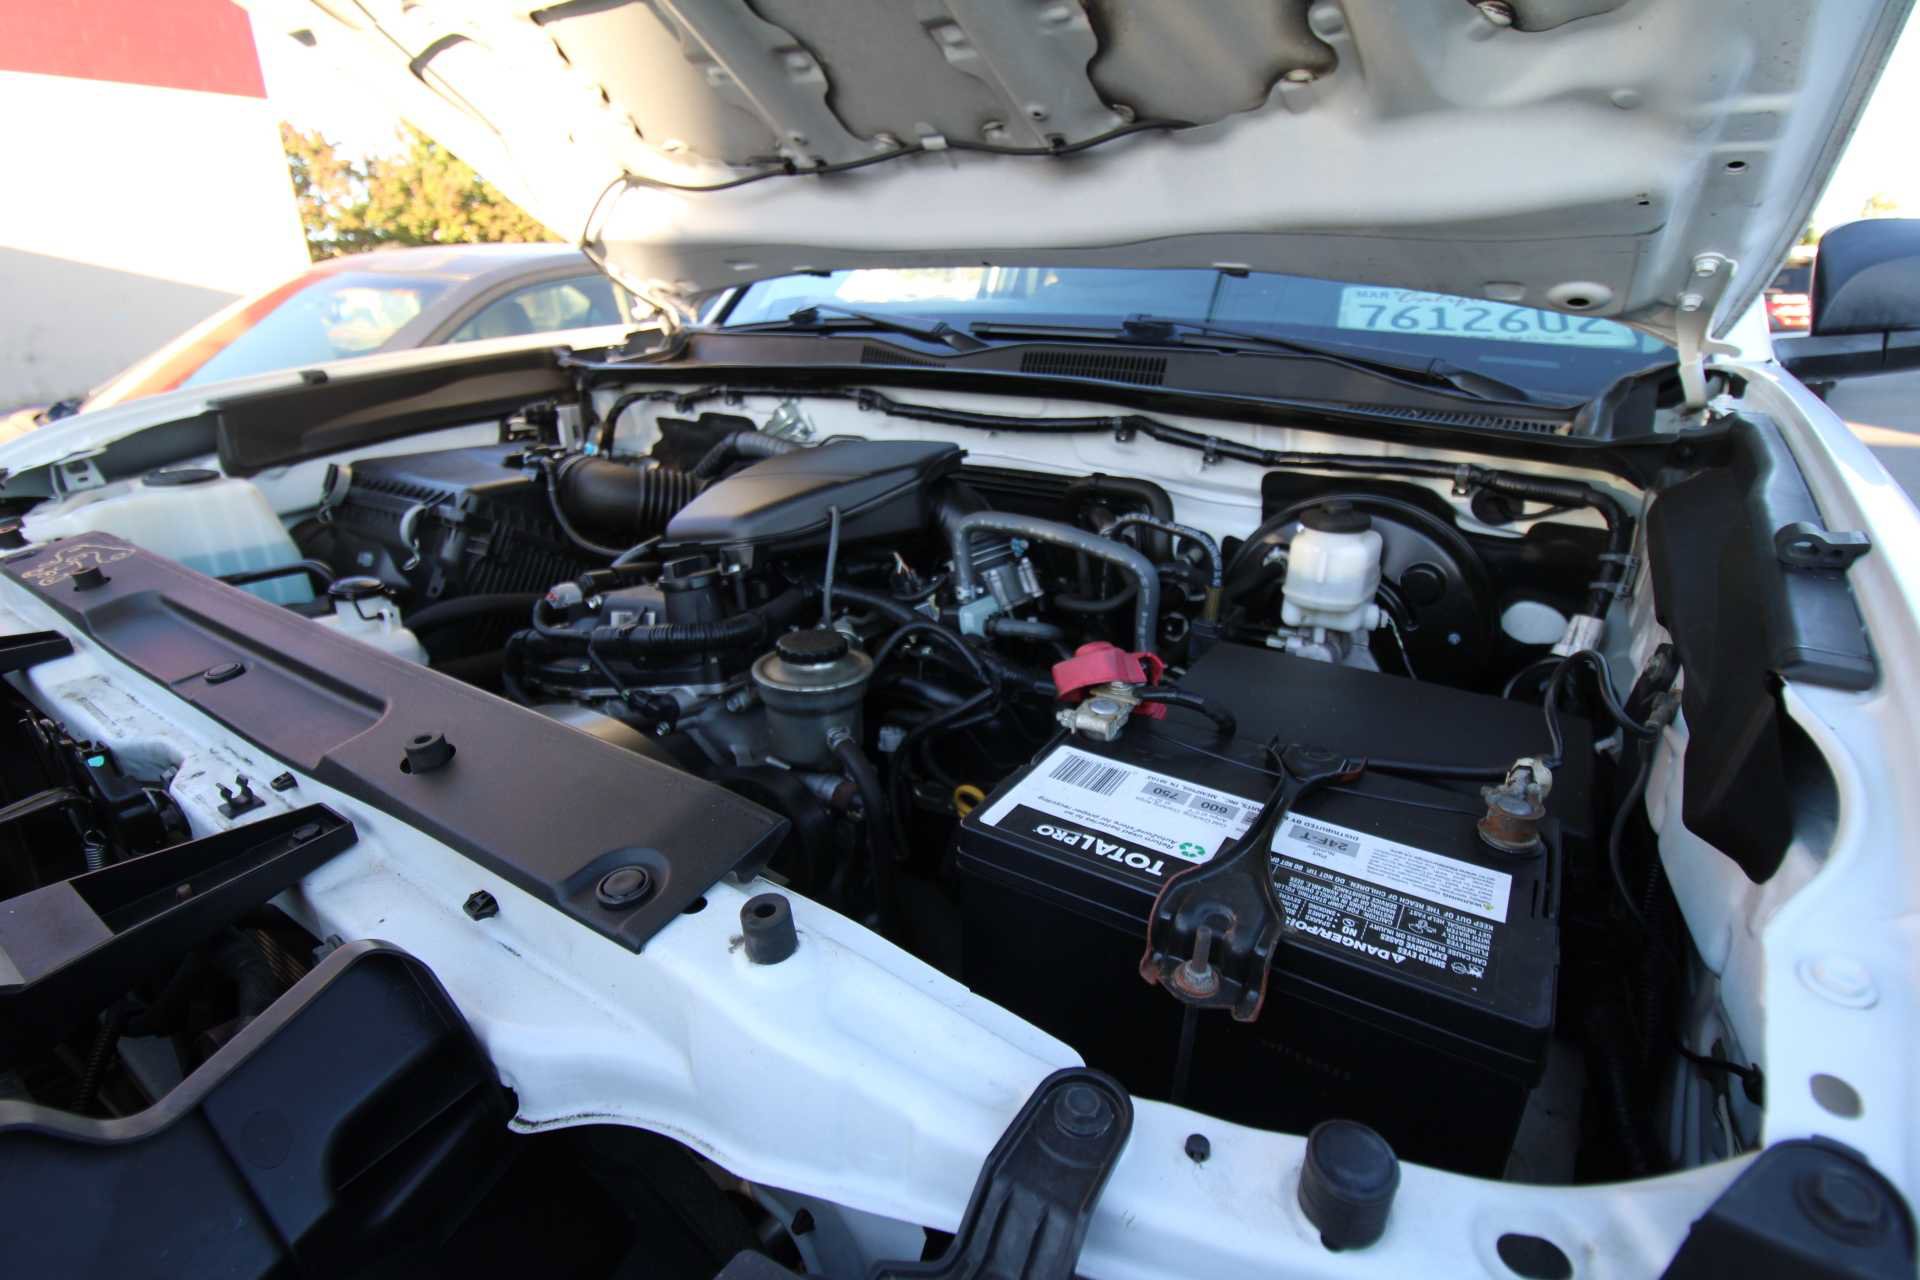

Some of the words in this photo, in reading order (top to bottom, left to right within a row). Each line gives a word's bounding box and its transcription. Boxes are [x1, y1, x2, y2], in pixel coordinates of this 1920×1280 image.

[1359, 304, 1611, 335] 7612602
[1152, 787, 1178, 799] 750
[1200, 801, 1227, 813] 600
[1299, 831, 1347, 850] 24F-T
[1279, 859, 1293, 867] NOT
[1318, 871, 1333, 880] NOT
[1334, 876, 1345, 884] DO
[1308, 902, 1335, 915] SMOKING
[1327, 900, 1346, 909] JUMP
[1399, 897, 1424, 909] REACH
[1307, 909, 1333, 921] FLAMES
[1425, 905, 1440, 915] THE
[1443, 911, 1453, 919] OF
[1304, 914, 1330, 927] SPARKS
[1427, 915, 1444, 925] HELP
[1455, 915, 1471, 924] OUT
[1473, 921, 1493, 930] KEEP
[1342, 925, 1357, 936] NO
[1369, 923, 1394, 935] INJURY
[1446, 921, 1474, 933] MEDICAL
[1380, 933, 1404, 946] GASES
[1395, 931, 1405, 939] OR
[1471, 934, 1490, 944] WITH
[1474, 929, 1491, 939] GET
[1406, 935, 1445, 952] BLINDNESS
[1441, 932, 1489, 950] IMMEDIATELY
[1446, 938, 1463, 948] EYES
[1397, 946, 1417, 958] EYES
[1405, 941, 1447, 960] EXPLOSIVE
[1447, 948, 1470, 960] CAUSE
[1465, 944, 1488, 956] FLUSH
[1418, 953, 1445, 968] SHIELD
[1471, 956, 1486, 966] CAN
